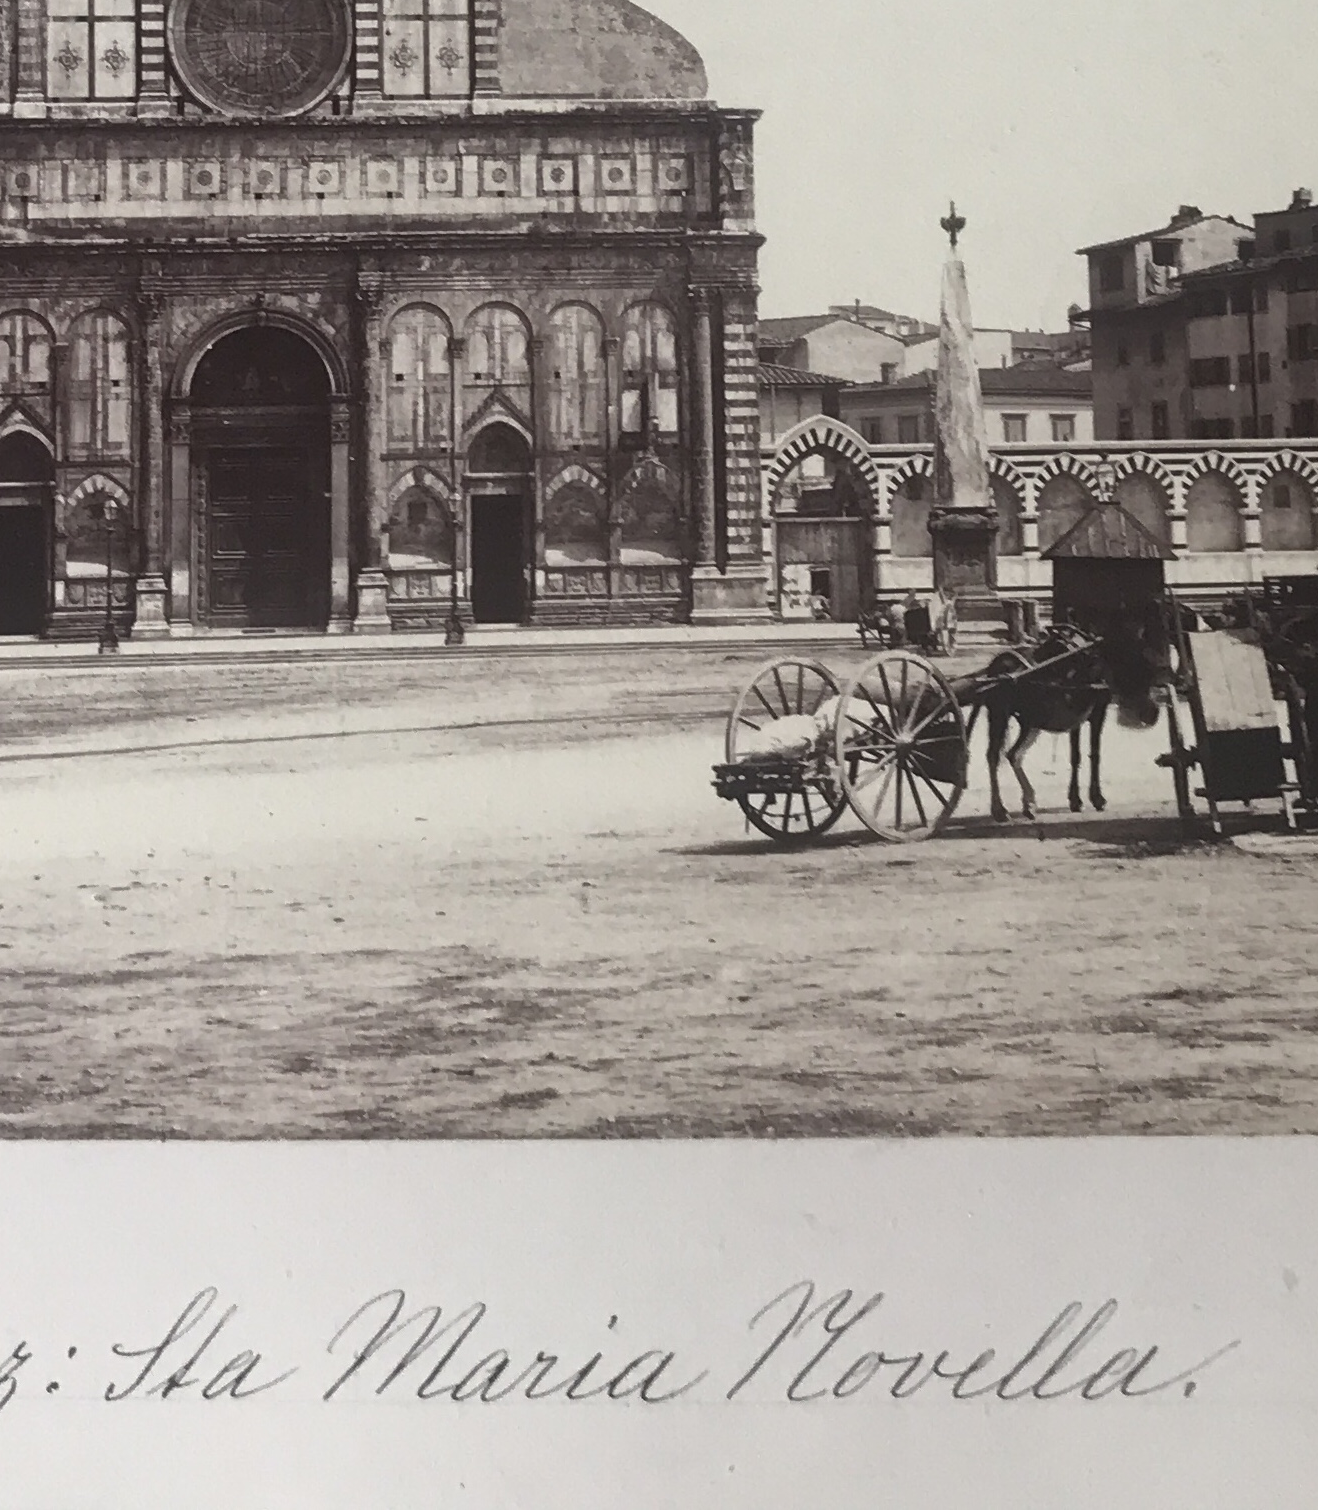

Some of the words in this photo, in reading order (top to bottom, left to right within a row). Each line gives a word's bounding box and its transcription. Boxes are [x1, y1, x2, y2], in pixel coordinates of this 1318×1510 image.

[102, 1285, 299, 1405] Sta
[321, 1287, 710, 1407] Maria
[725, 1278, 1241, 1406] Novella.
